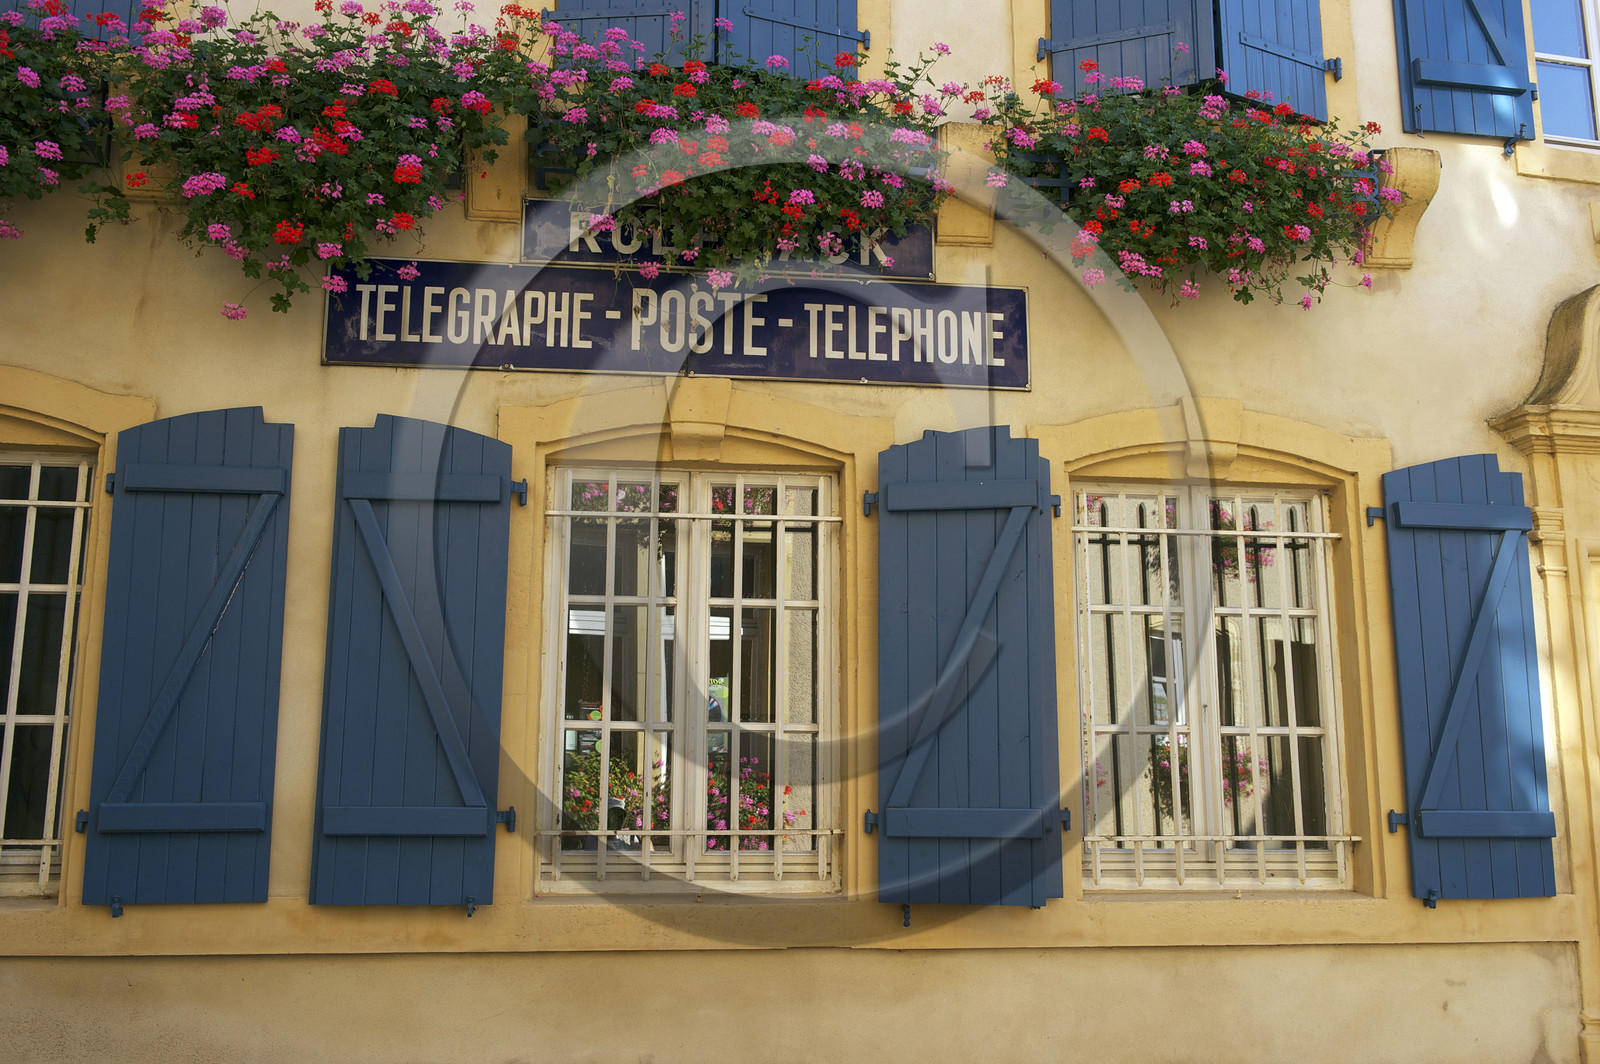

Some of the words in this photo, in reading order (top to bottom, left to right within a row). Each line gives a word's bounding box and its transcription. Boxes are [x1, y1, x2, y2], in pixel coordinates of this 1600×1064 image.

[356, 284, 594, 349] TELEGRAPHE
[631, 287, 768, 356] POSTE
[804, 303, 1006, 366] TELEPHONE
